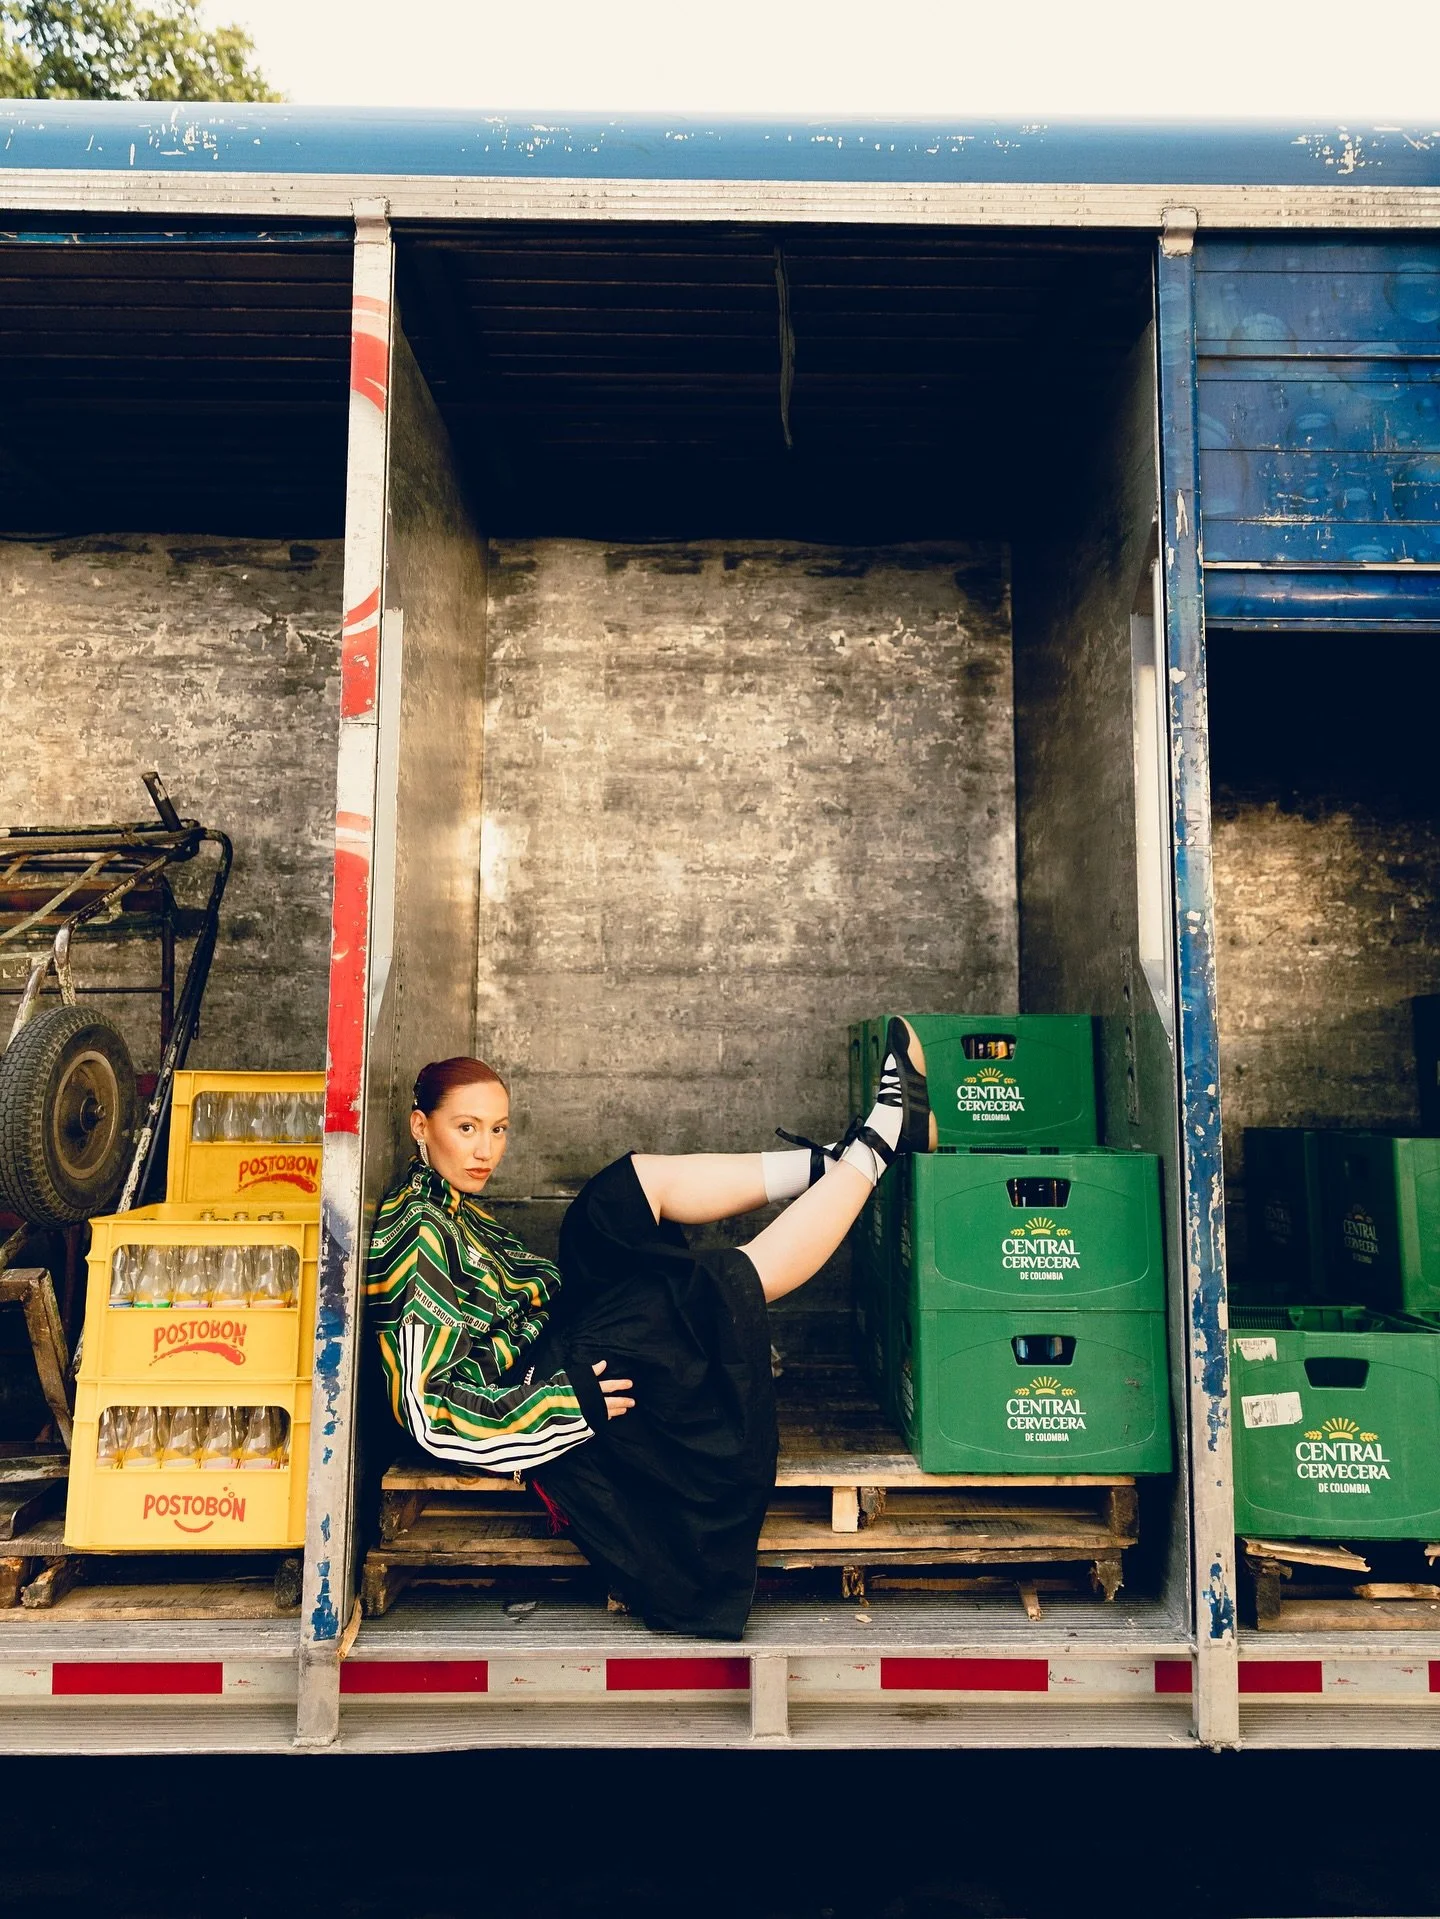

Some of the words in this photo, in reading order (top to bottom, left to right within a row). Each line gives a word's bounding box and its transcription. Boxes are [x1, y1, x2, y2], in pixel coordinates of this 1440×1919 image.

[957, 1086, 1025, 1100] CENTRAL
[957, 1101, 1025, 1112] CERVECERA
[973, 1113, 981, 1121] DE
[982, 1113, 1011, 1121] COLOMBIA
[1002, 1239, 1081, 1255] CENTRAL
[1002, 1255, 1081, 1269] CERVECERA
[1020, 1272, 1029, 1281] DE
[1030, 1272, 1064, 1281] COLOMBIA
[1006, 1399, 1087, 1416] CENTRAL
[1006, 1416, 1087, 1430] CERVECERA
[1025, 1433, 1034, 1442] DE
[1035, 1433, 1069, 1442] COLOMBIA
[1296, 1442, 1391, 1463] CENTRAL
[1296, 1463, 1391, 1480] CERVECERA
[1318, 1483, 1329, 1494] DE
[1329, 1482, 1371, 1494] COLOMBIA
